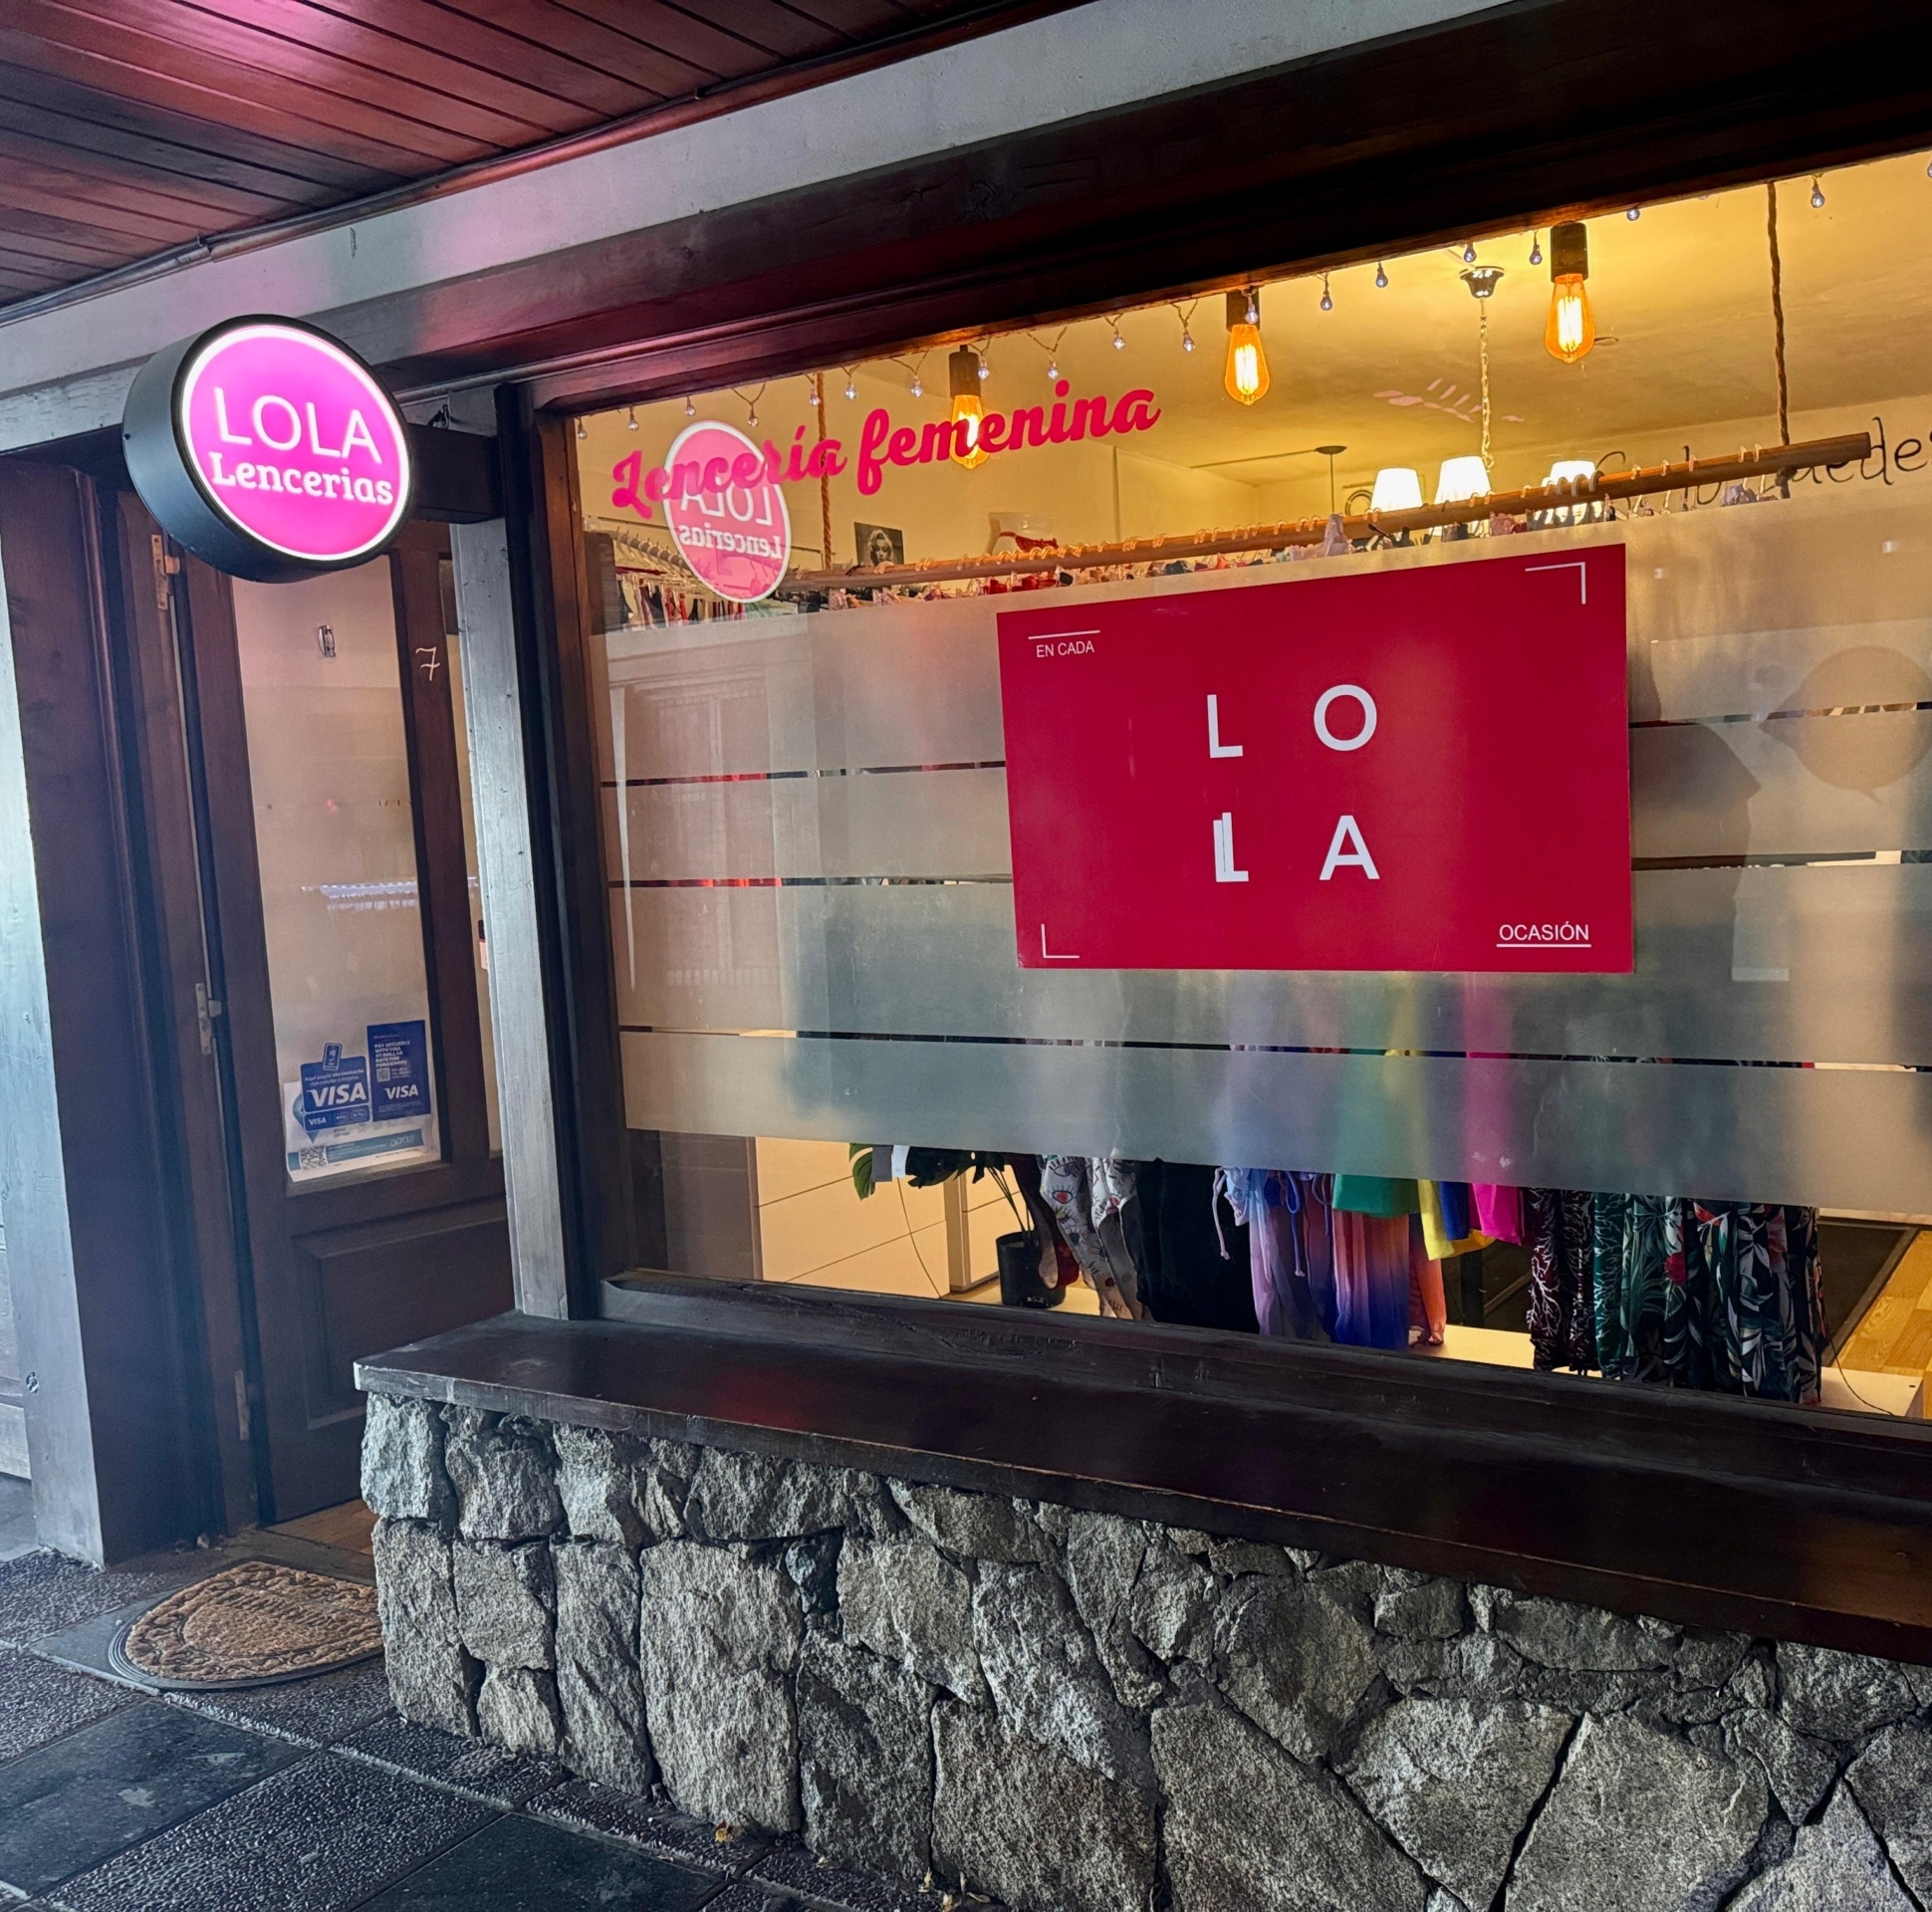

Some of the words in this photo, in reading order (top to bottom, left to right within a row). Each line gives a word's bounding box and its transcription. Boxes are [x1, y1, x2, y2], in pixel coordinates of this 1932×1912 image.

[214, 386, 381, 464] LOLA
[611, 425, 847, 520] Lencería
[856, 379, 1162, 496] femenina
[209, 451, 394, 505] Lencerias
[1036, 643, 1055, 658] EN
[1058, 640, 1094, 656] CADA
[416, 646, 441, 681] 7
[1499, 920, 1589, 941] OCASIÓN
[306, 1081, 367, 1108] VISA
[383, 1083, 419, 1100] VISA
[309, 1116, 327, 1125] VISA
